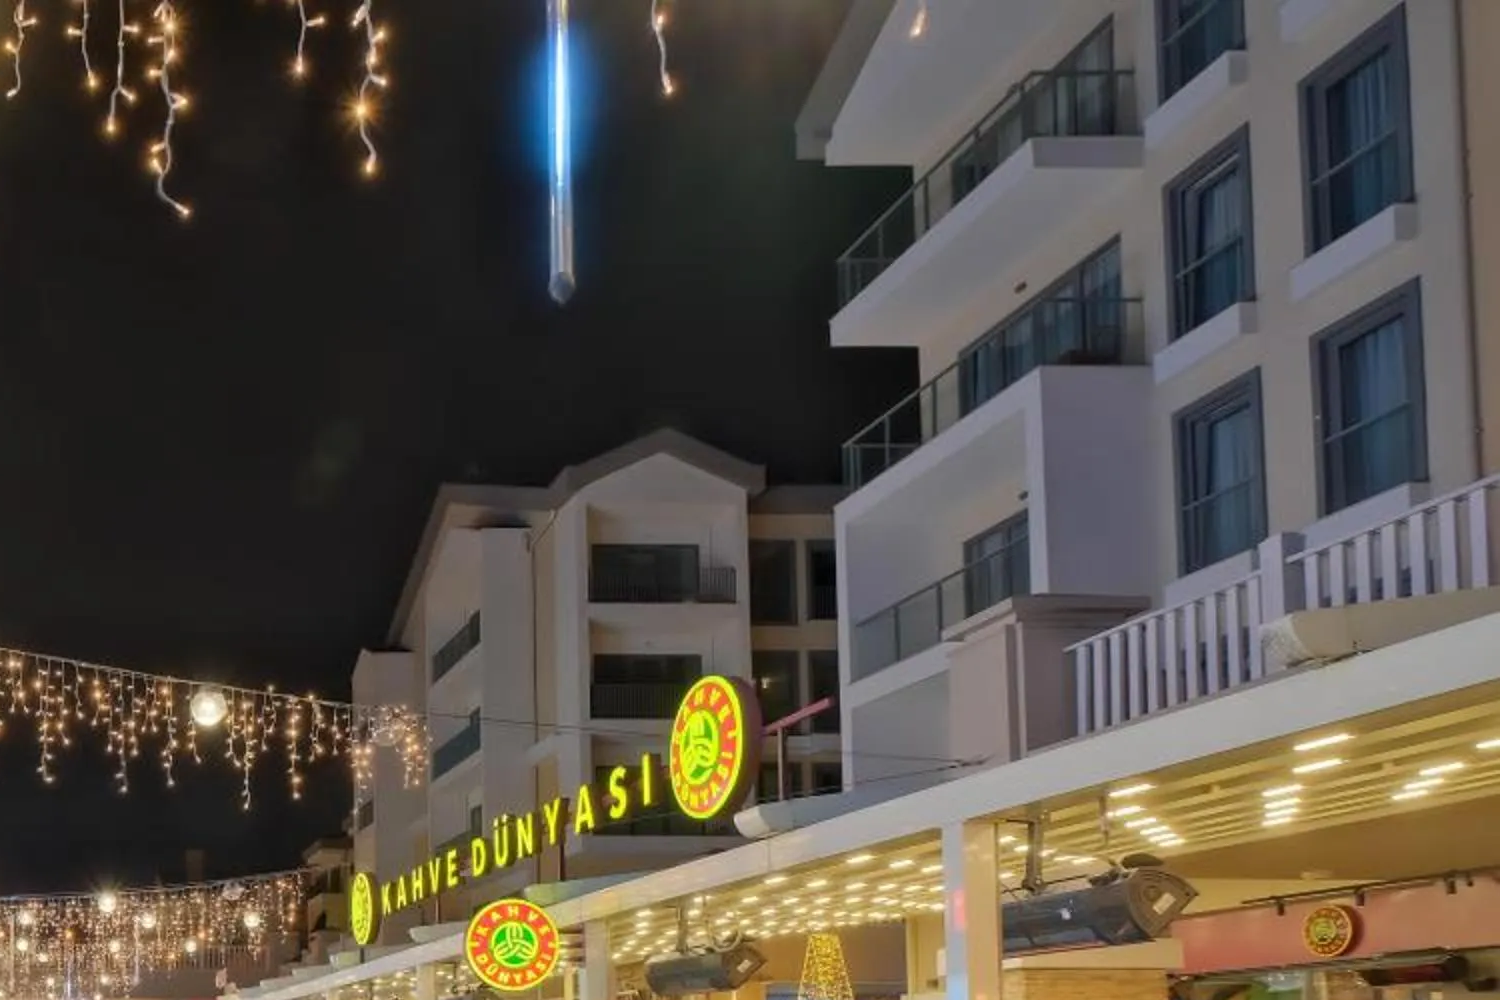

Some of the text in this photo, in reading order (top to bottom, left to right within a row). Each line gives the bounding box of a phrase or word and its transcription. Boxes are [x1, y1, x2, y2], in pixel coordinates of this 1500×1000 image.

[381, 849, 458, 916] KAHVE
[471, 752, 651, 878] DÜNYASI
[476, 905, 551, 937] KAHVE
